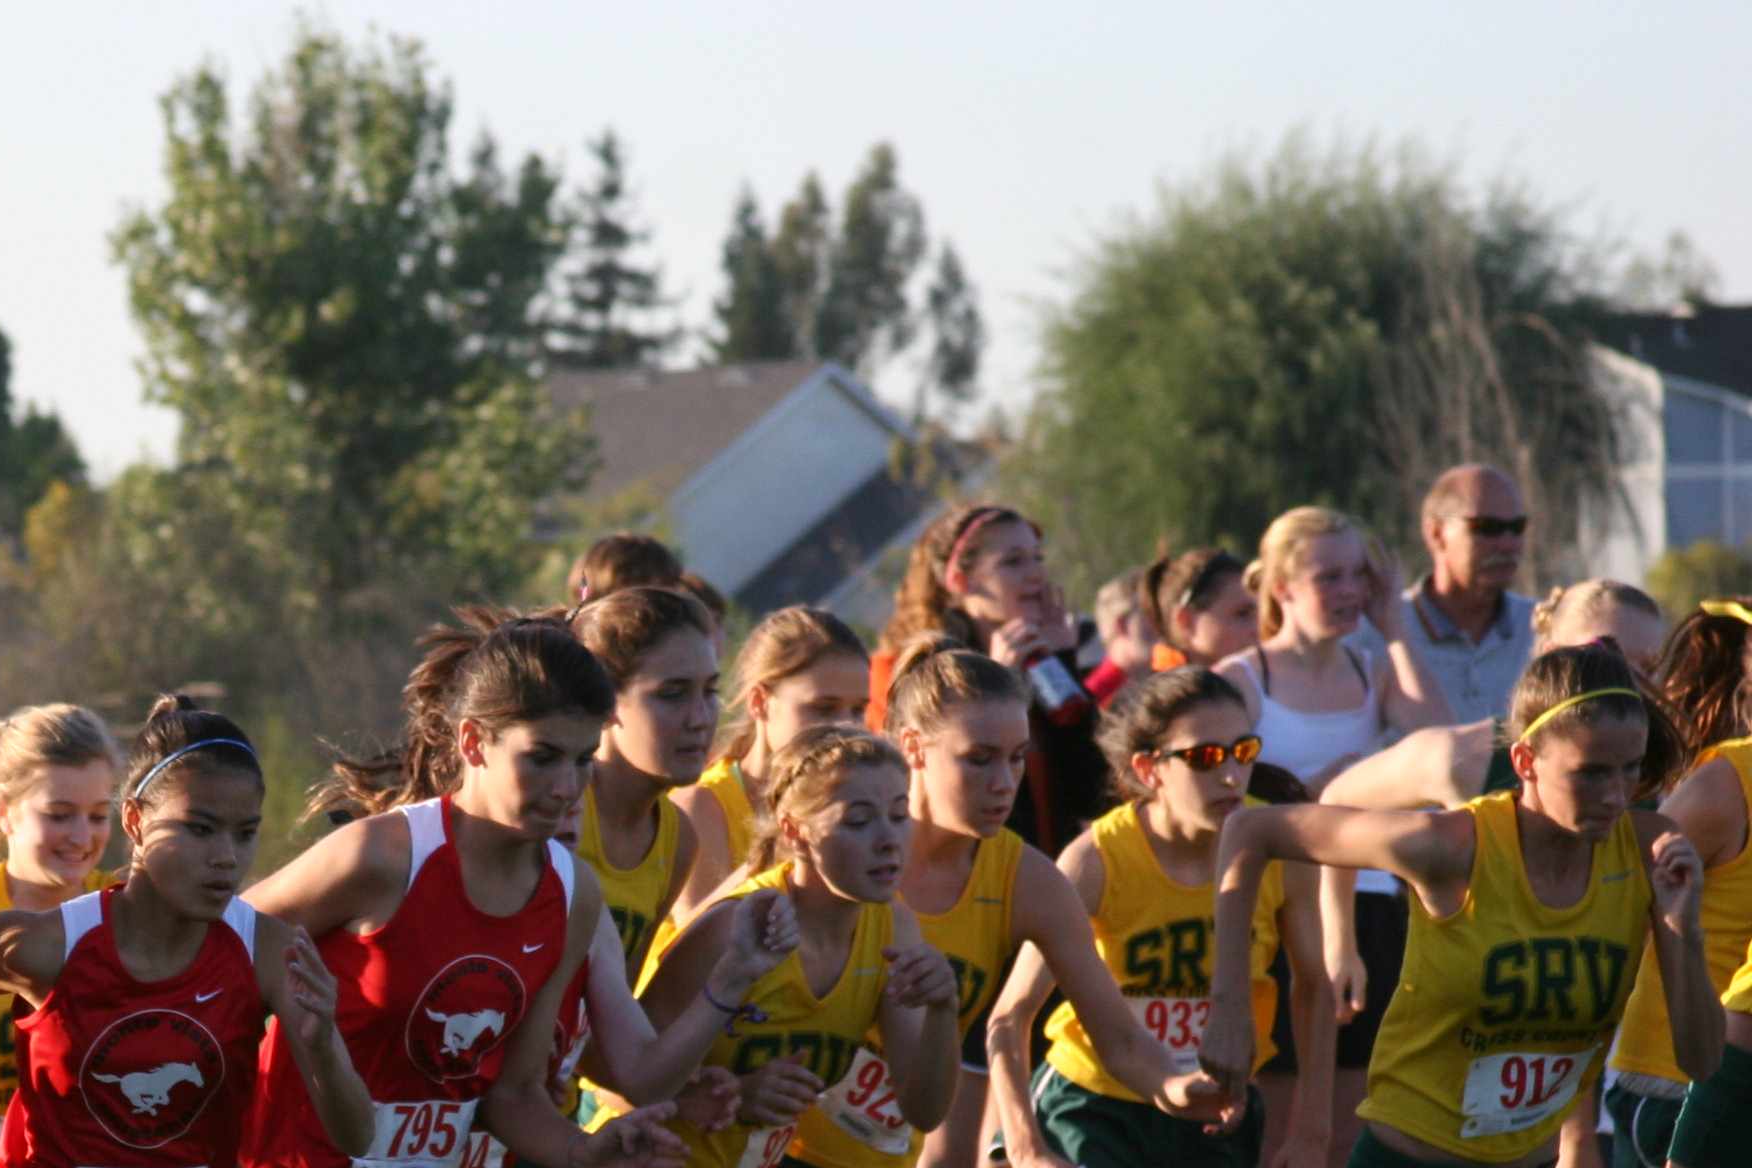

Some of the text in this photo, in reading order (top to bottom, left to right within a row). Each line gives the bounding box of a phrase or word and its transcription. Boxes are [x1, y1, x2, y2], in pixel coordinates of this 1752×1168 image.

[1125, 919, 1215, 990] SR
[1480, 936, 1630, 1026] SRV
[1500, 1055, 1574, 1109] 912
[387, 1103, 460, 1158] 795
